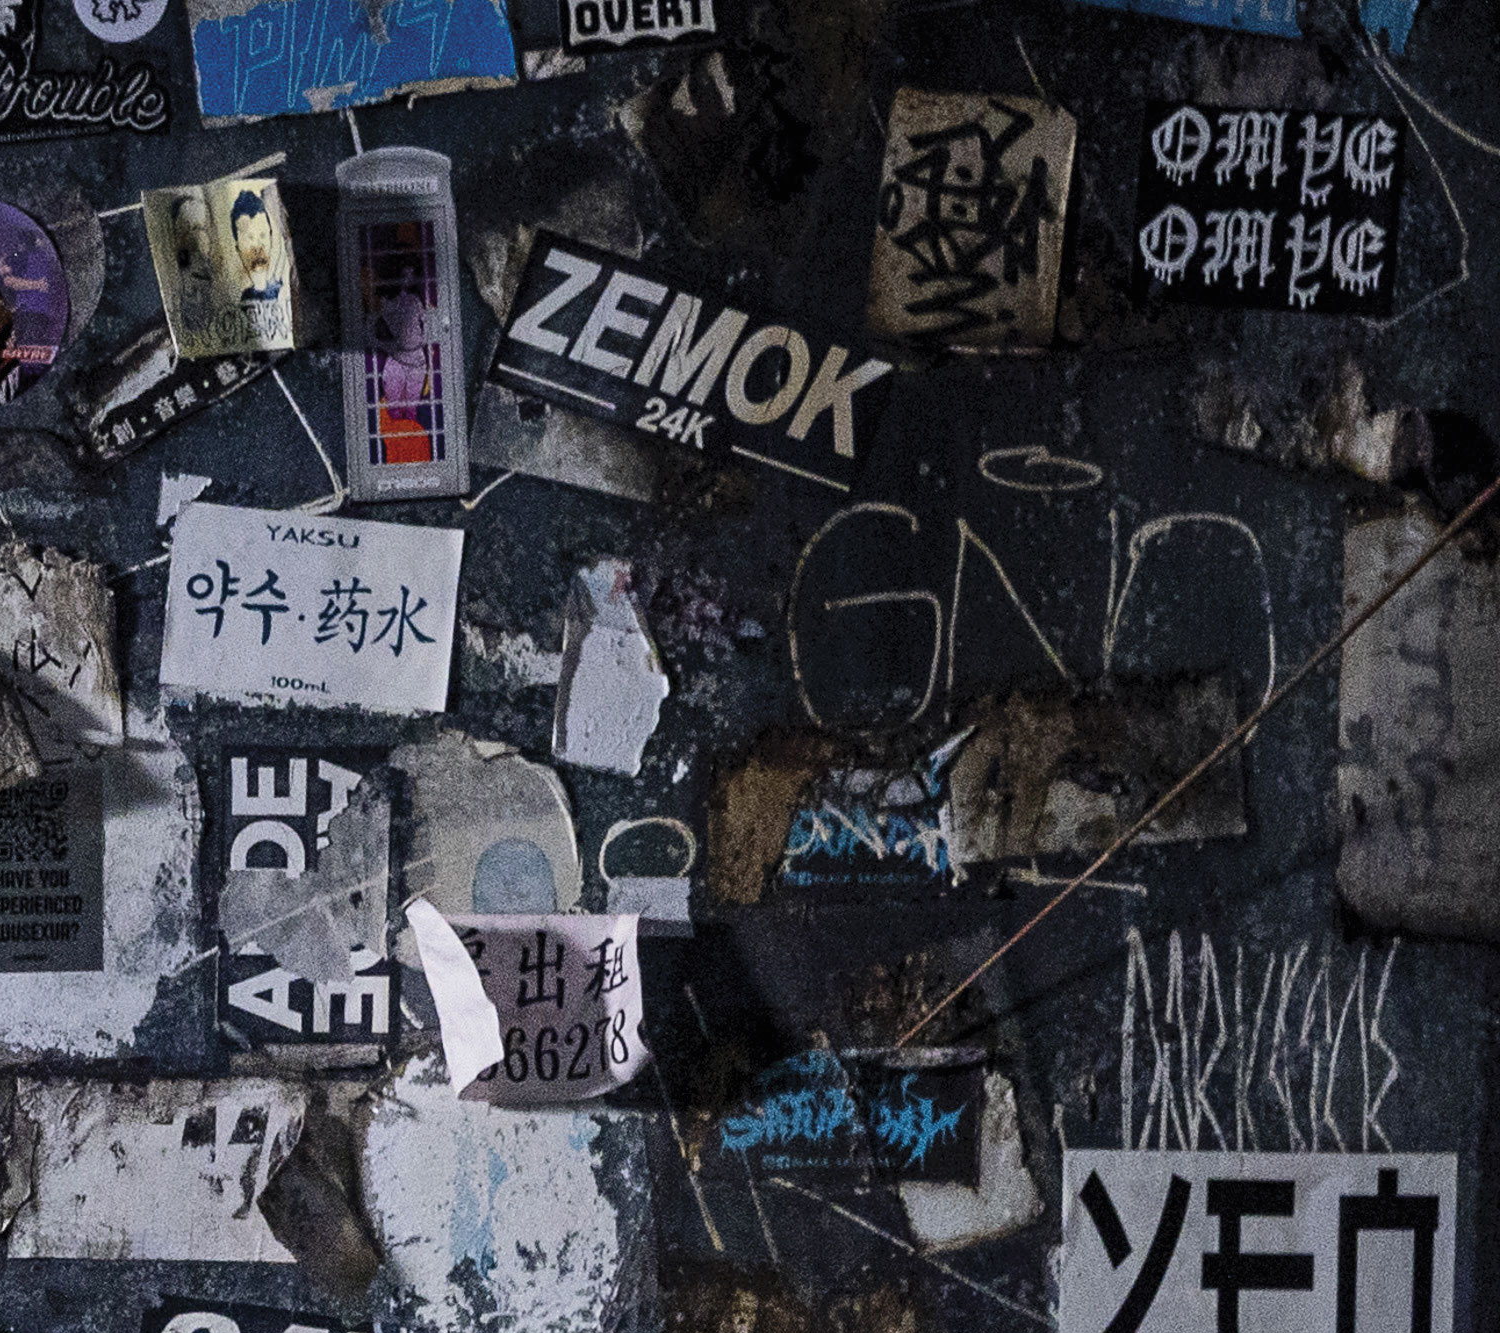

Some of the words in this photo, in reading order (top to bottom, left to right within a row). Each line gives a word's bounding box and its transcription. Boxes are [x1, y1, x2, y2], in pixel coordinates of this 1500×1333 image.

[509, 248, 892, 460] ZEMOK
[636, 396, 715, 452] 24K
[266, 523, 360, 550] YAKSU
[40, 869, 71, 889] YOU
[227, 757, 308, 1033] ADE
[477, 1008, 630, 1083] 66278
